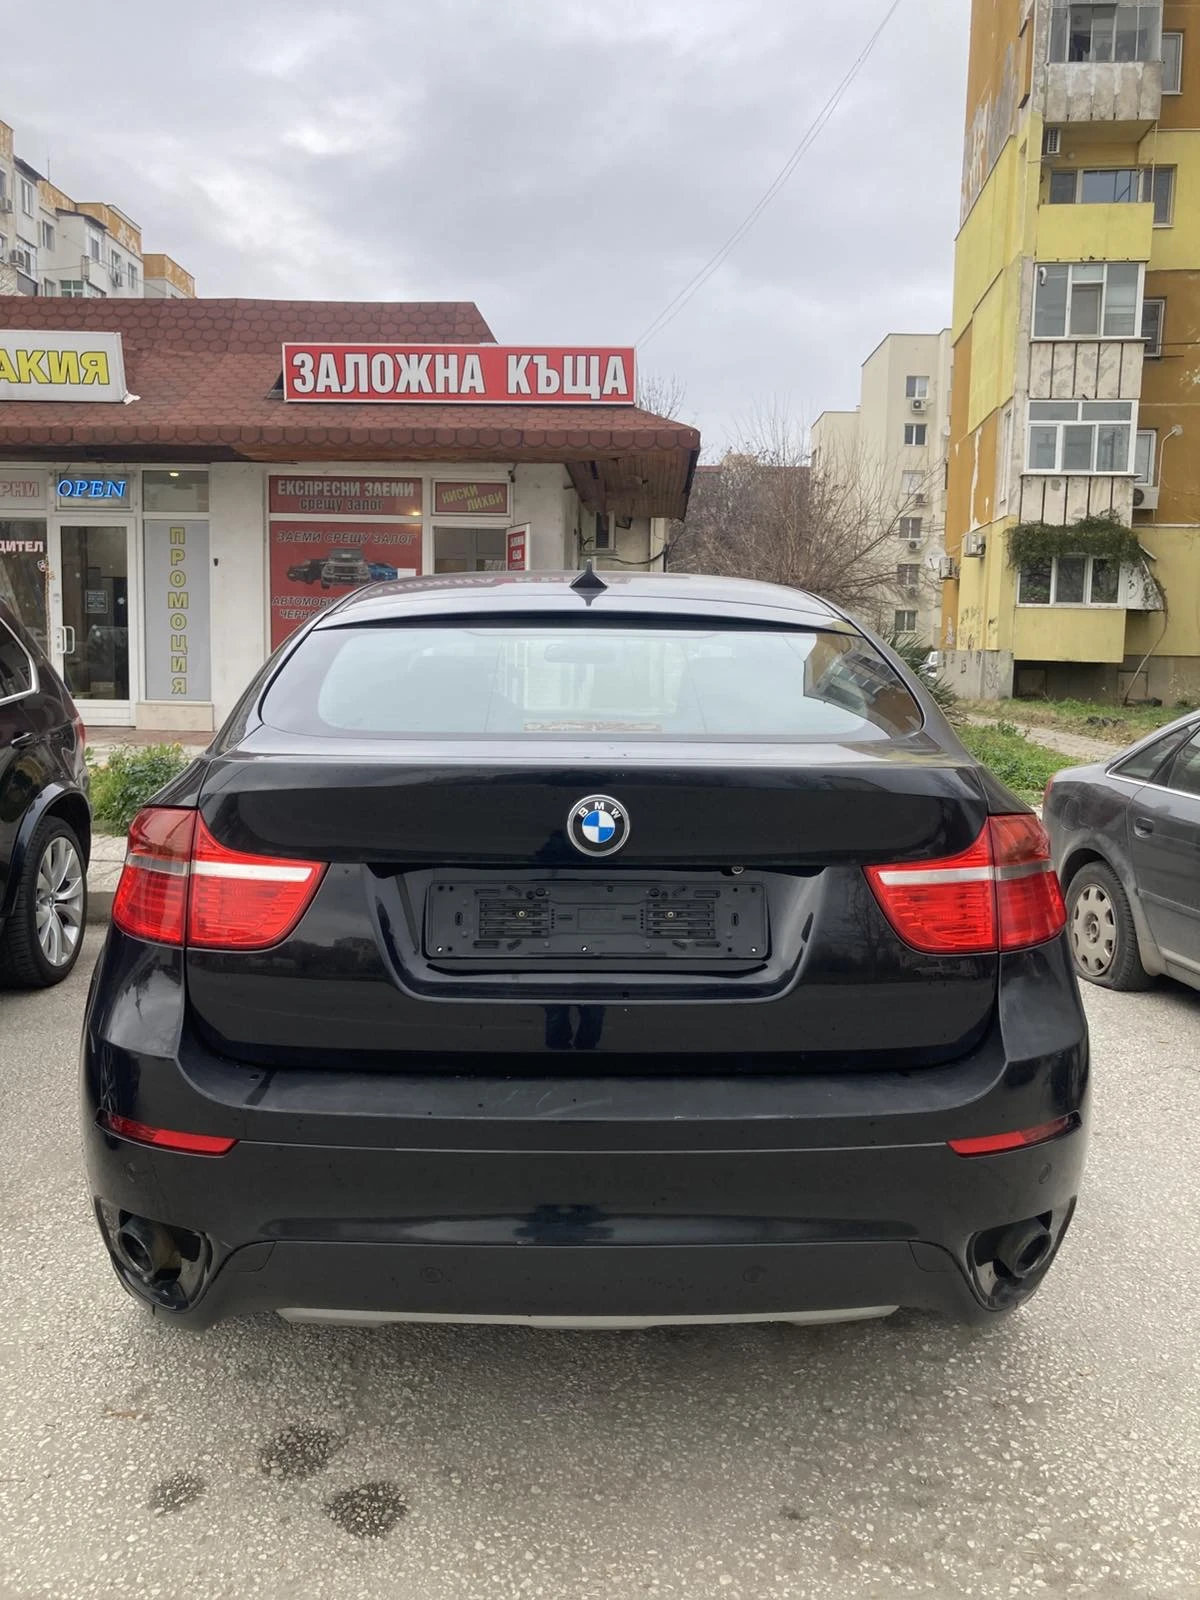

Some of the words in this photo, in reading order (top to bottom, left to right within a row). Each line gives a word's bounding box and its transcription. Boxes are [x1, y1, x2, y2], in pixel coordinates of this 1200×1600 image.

[0, 349, 110, 385] АКИЯ
[292, 352, 486, 394] ЗАЛОЖНА
[507, 354, 629, 400] КЪЩА
[57, 479, 126, 498] OPEN
[277, 479, 360, 496] ЕКСПРЕСНИ
[364, 482, 414, 497] ЗАЕМИ
[441, 484, 479, 504] НИСКИ
[300, 499, 342, 512] срещу
[467, 491, 504, 512] ЛИХВИ
[277, 530, 322, 544] ЗАЕМИ
[324, 531, 369, 545] СРЕЩУ
[372, 533, 417, 545] ЗАЛОГ
[167, 526, 190, 695] ПРОМОЦИЯ
[578, 802, 621, 819] BMW
